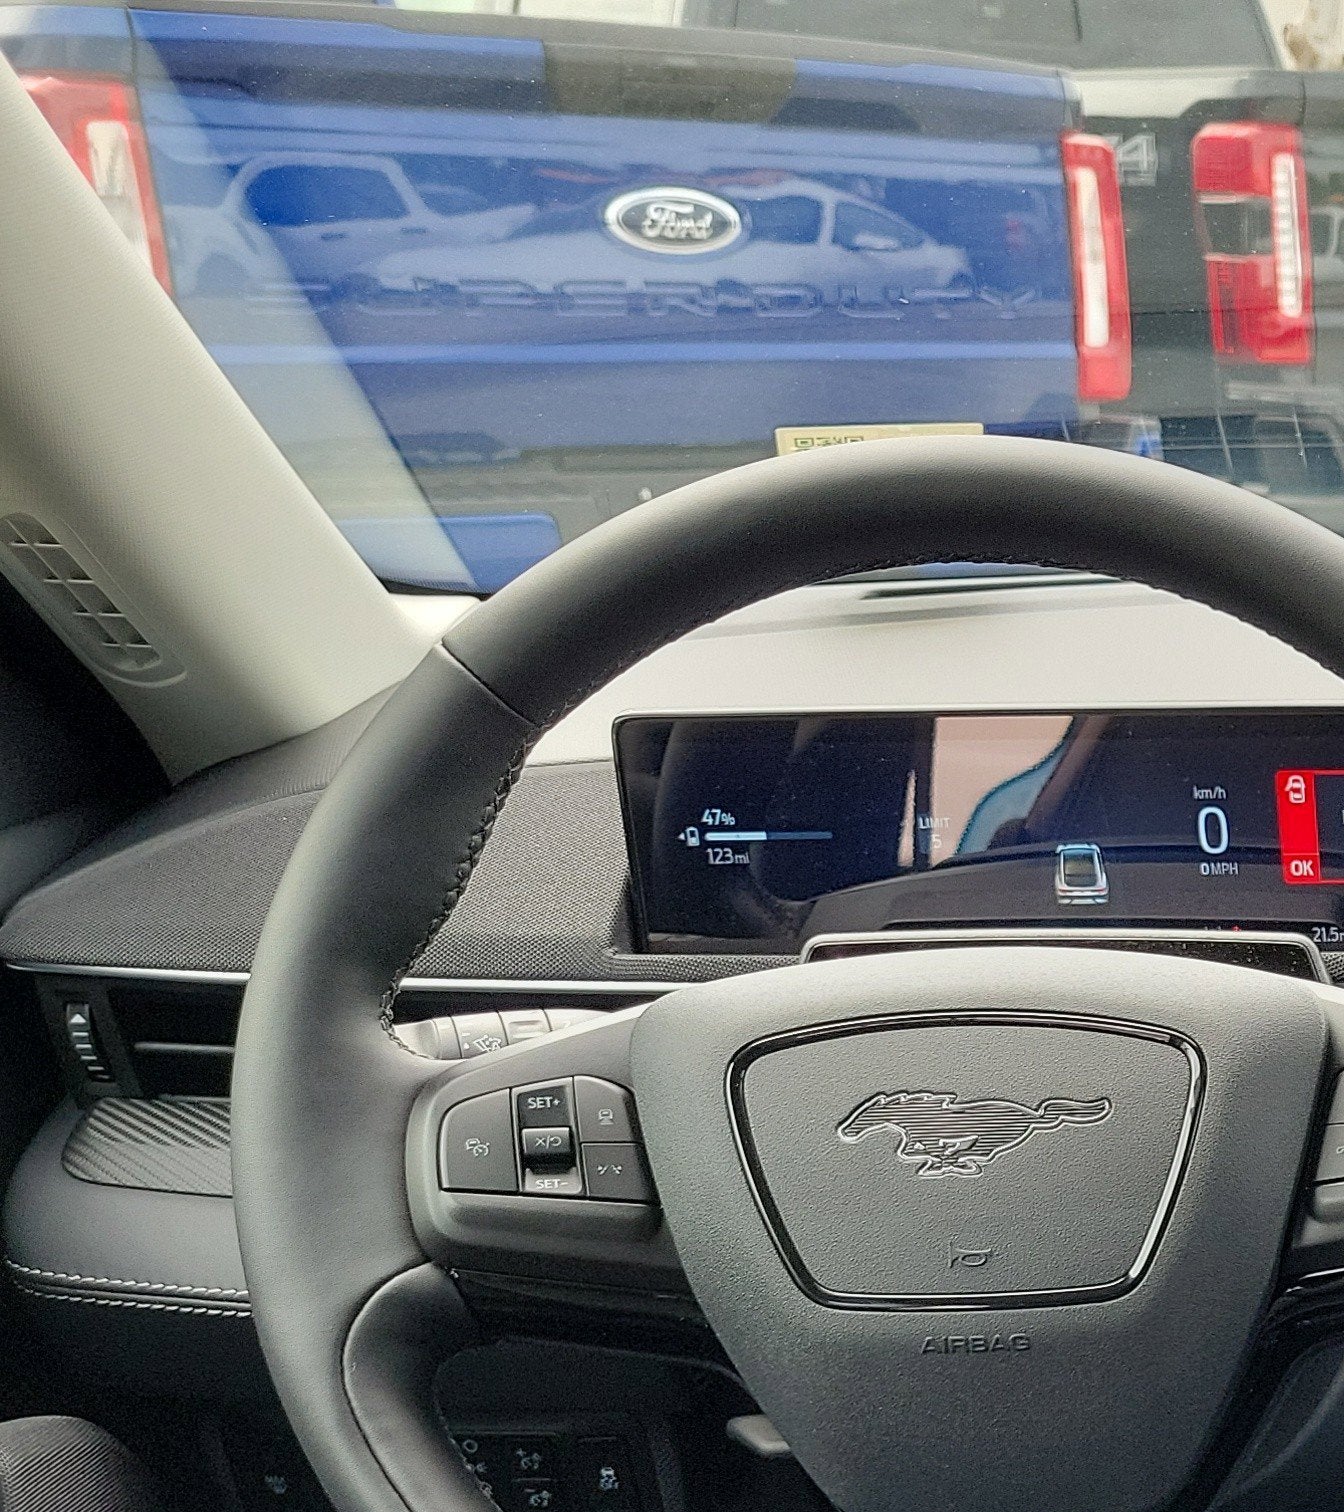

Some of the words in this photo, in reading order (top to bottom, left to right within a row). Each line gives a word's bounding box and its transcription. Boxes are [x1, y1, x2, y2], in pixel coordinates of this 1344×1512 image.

[641, 201, 715, 240] Ford
[1192, 785, 1227, 801] km/h
[700, 808, 736, 827] 47%
[918, 816, 950, 830] LIMIT
[1197, 805, 1230, 855] 0
[1290, 860, 1315, 877] OK
[920, 1333, 1031, 1355] AIRBAG
